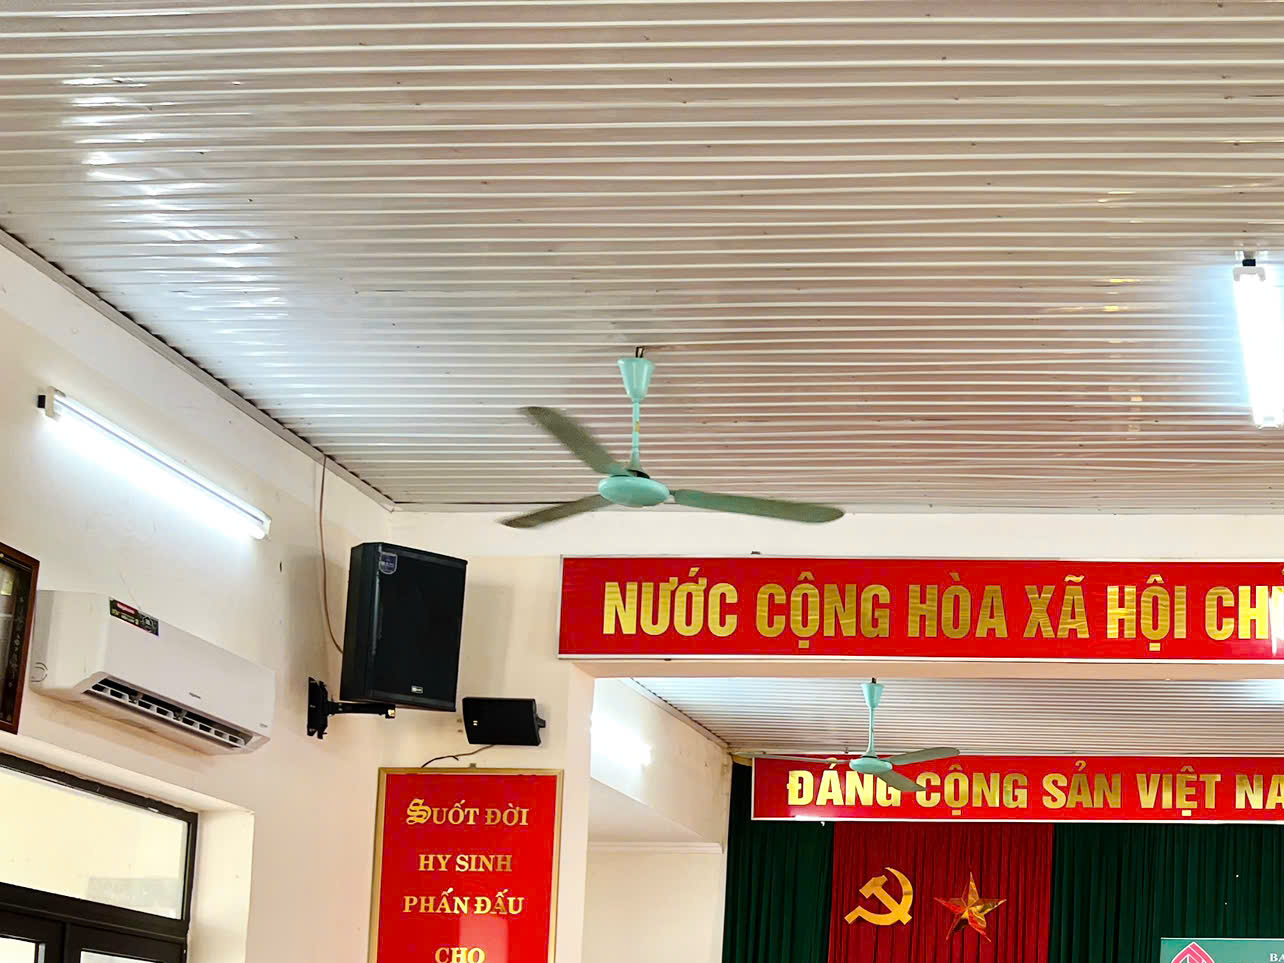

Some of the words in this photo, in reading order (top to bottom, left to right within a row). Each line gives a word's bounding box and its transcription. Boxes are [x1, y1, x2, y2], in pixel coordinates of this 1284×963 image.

[602, 567, 738, 636] NƯỚC
[756, 571, 891, 649] CỘNG
[907, 572, 1009, 639] HÒA
[1023, 574, 1090, 639] XÃ
[1106, 574, 1187, 652] HỘI
[915, 763, 1028, 817] CỘNG
[1041, 760, 1122, 809] SẢN
[1135, 766, 1222, 817] VIỆT
[406, 798, 479, 825] SUỐT
[485, 803, 530, 826] ĐỜI
[418, 854, 451, 871] HY
[455, 854, 513, 872] SINH
[402, 887, 470, 914] PHẤN
[474, 889, 525, 915] ĐẤU
